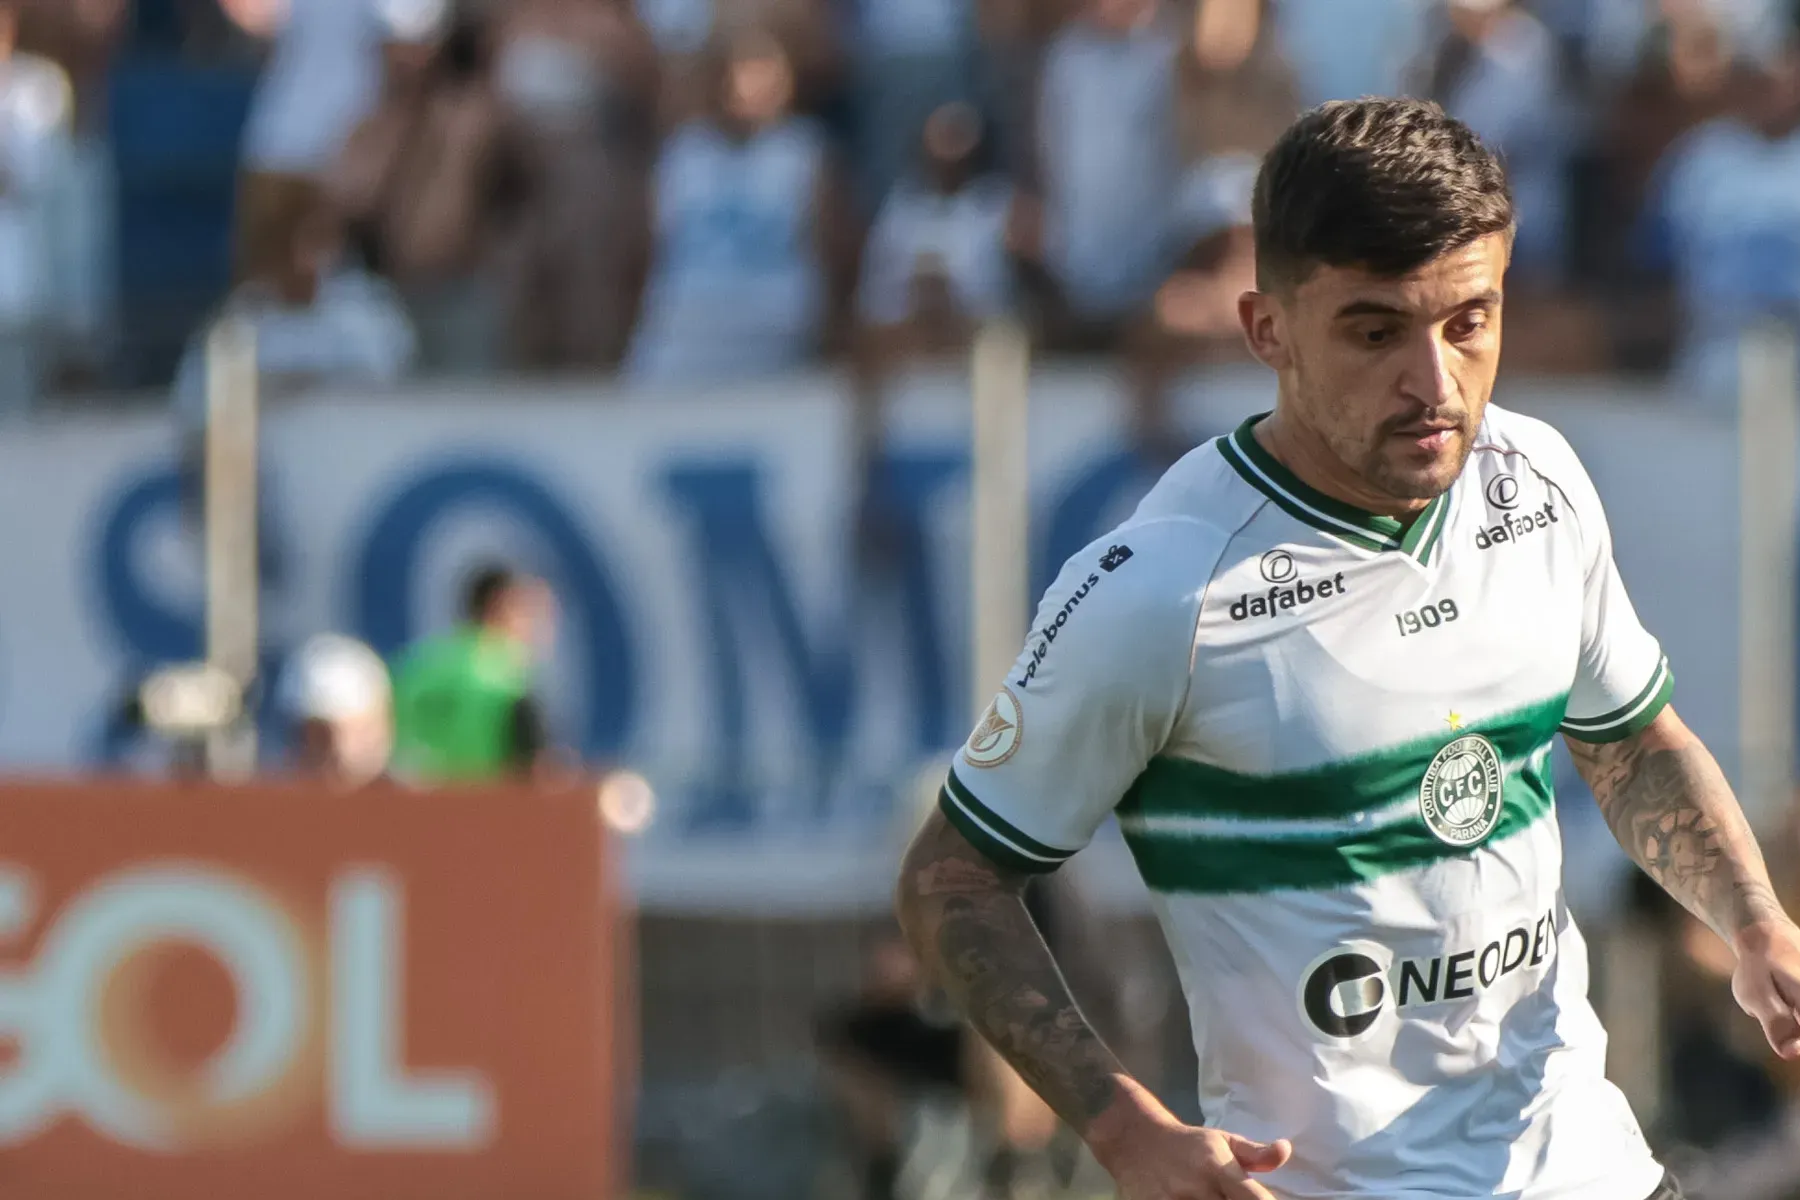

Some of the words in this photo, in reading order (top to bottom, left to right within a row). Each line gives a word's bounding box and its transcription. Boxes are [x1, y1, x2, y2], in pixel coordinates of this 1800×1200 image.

[1475, 501, 1559, 550] dafabet
[1229, 571, 1347, 621] dafabet
[1394, 597, 1460, 637] 1909
[1423, 760, 1443, 818] CORITIBA
[1485, 758, 1498, 793] CLUB
[1439, 770, 1483, 807] CFC
[0, 858, 497, 1152] OL
